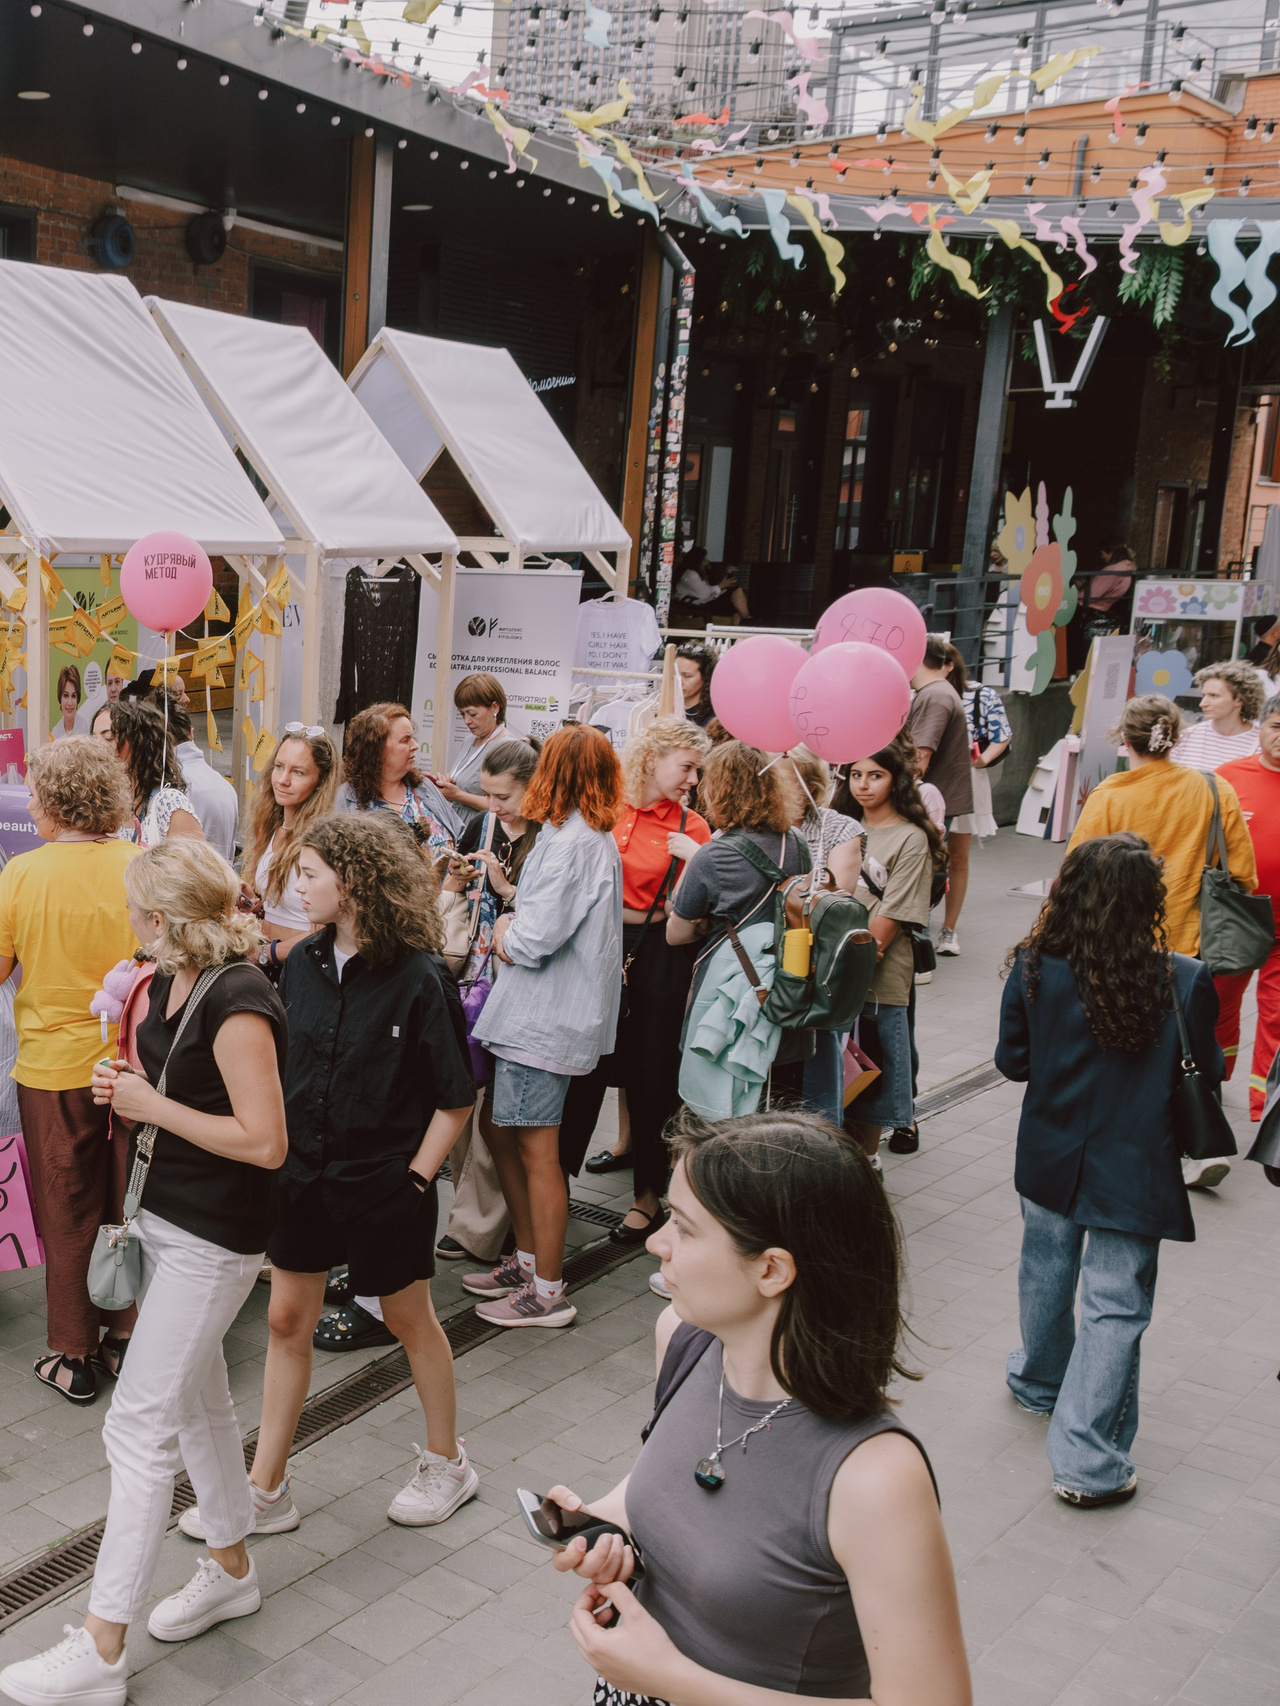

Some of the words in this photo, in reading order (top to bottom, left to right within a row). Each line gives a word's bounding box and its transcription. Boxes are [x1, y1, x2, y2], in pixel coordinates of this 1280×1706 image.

[144, 553, 197, 569] КУДРЯВЫЙ
[145, 566, 177, 580] МЕТОД
[607, 632, 627, 640] HAVE
[427, 653, 470, 663] СЫОТКА
[470, 655, 486, 663] ДЛЯ
[486, 656, 533, 666] УКРЕПЛЕНИЯ
[534, 659, 561, 667] ВОЛОС
[429, 662, 472, 671] ECIATRIA
[473, 665, 523, 675] PROFESSIONAL
[524, 668, 557, 677] BALANCE
